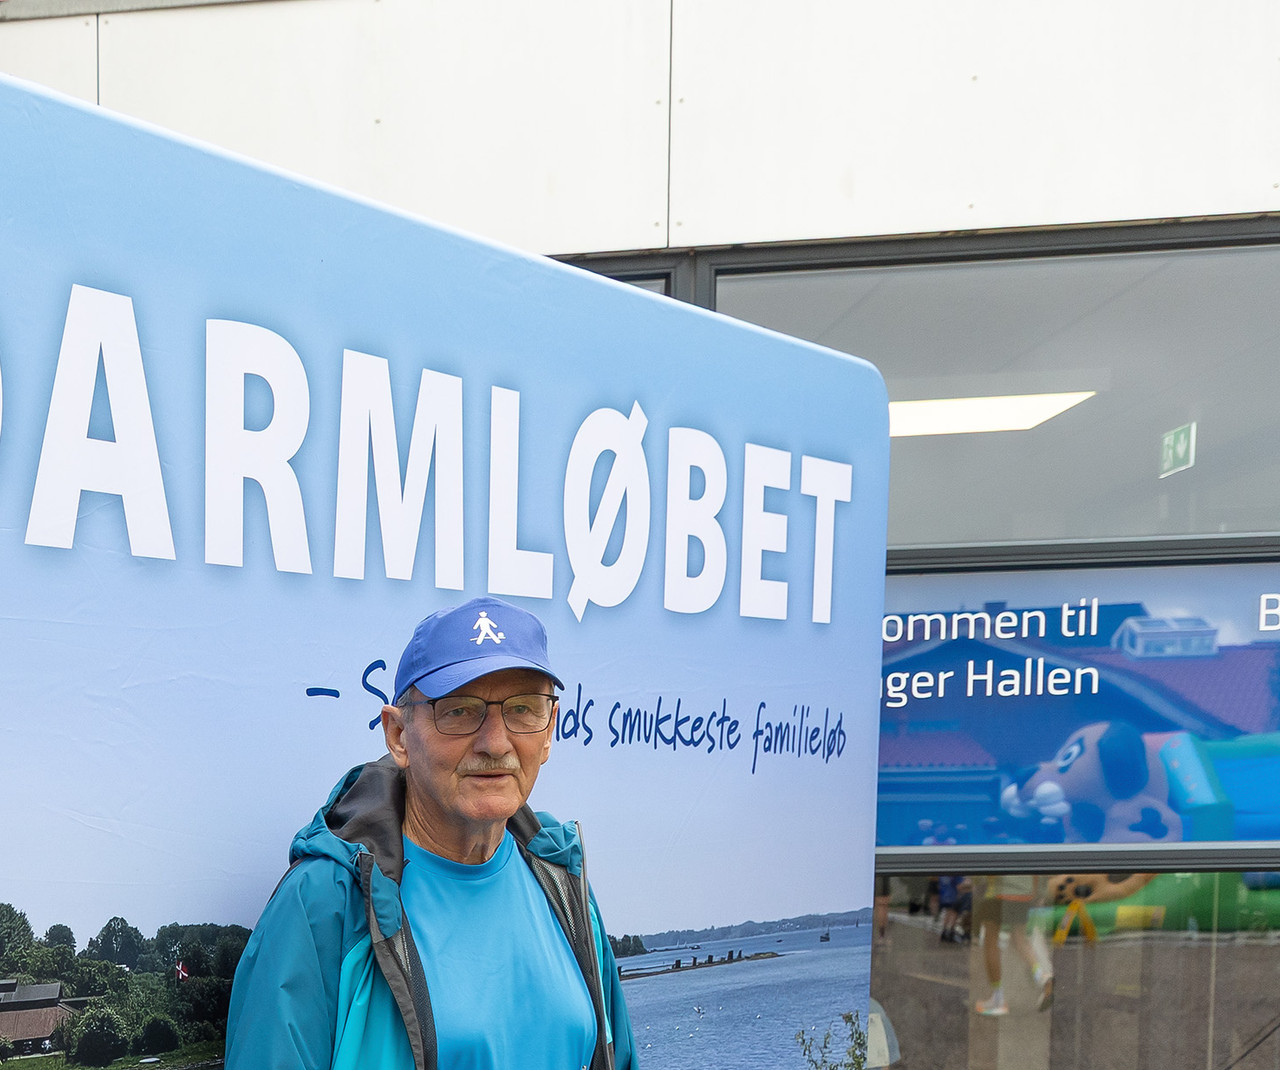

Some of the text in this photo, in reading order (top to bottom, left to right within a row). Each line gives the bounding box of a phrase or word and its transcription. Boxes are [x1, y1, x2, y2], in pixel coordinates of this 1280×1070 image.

[881, 597, 1100, 642] ommen til
[880, 657, 1100, 708] ger Hallen
[608, 695, 742, 752] smukkeste
[752, 704, 847, 774] familieløb
